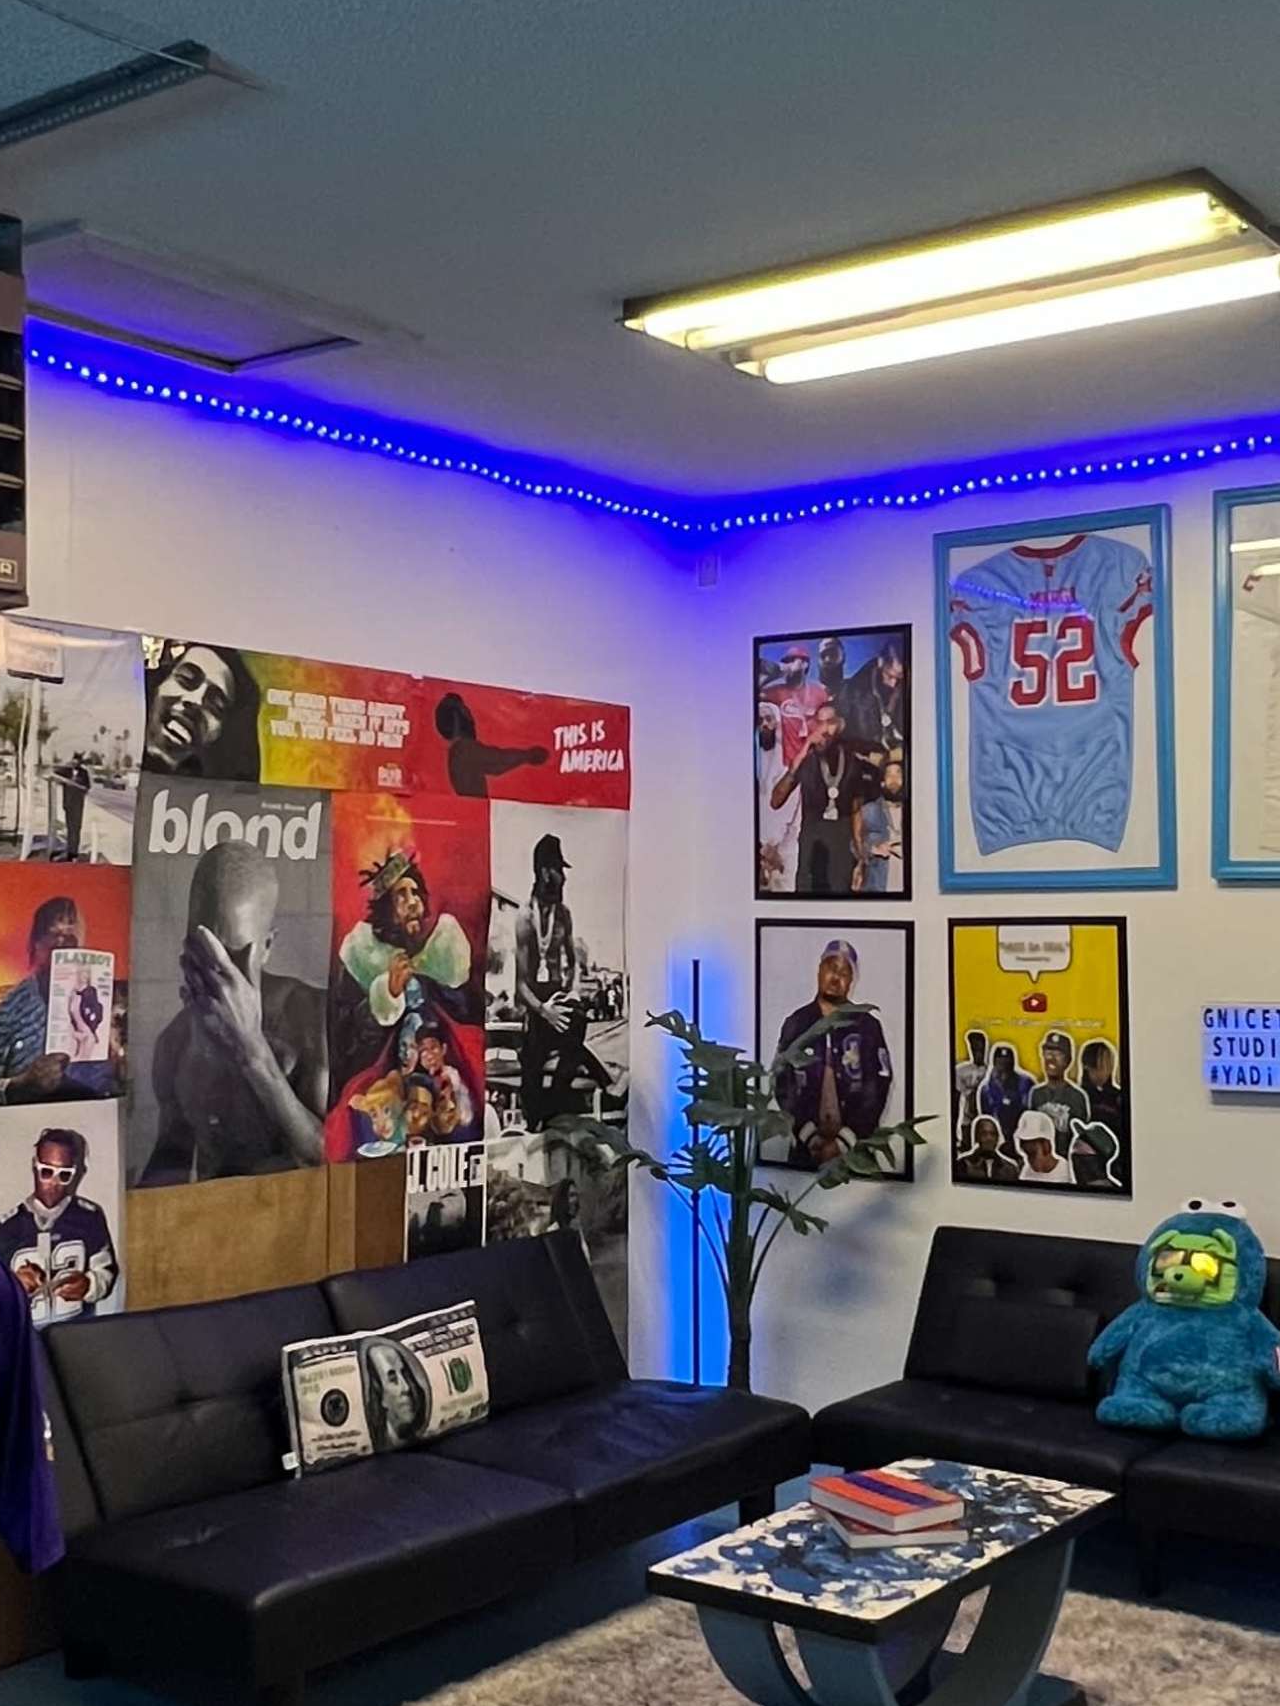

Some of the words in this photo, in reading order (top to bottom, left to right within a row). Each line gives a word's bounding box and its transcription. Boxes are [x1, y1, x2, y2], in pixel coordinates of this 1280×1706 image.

[1007, 613, 1099, 708] 52
[553, 723, 588, 751] THIS
[591, 719, 606, 743] IS
[560, 749, 624, 773] AMERICA
[148, 789, 322, 860] blond
